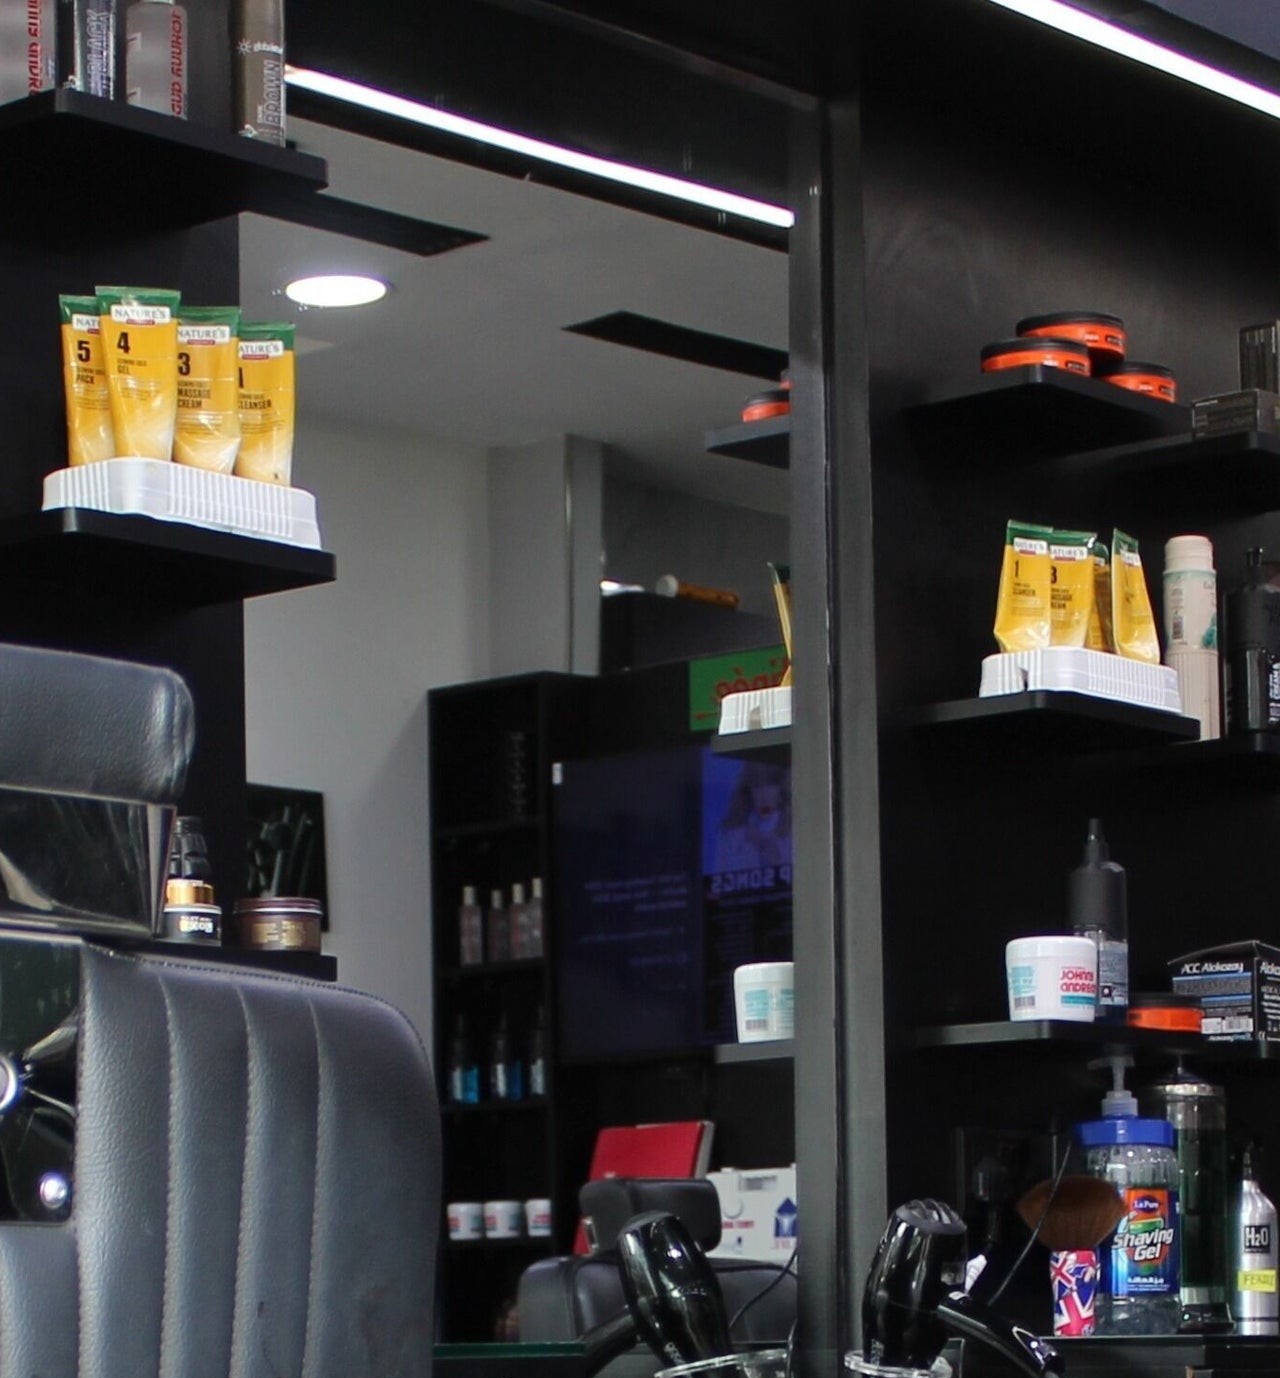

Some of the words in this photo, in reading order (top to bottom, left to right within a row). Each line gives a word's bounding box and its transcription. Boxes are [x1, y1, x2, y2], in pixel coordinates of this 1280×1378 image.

[115, 307, 167, 319] NATURE'S
[76, 340, 91, 362] 5
[117, 331, 131, 354] 4
[239, 342, 280, 354] ATURE'S
[177, 352, 191, 376] 3
[1113, 1228, 1175, 1250] Shaving
[1133, 1243, 1162, 1261] Gel
